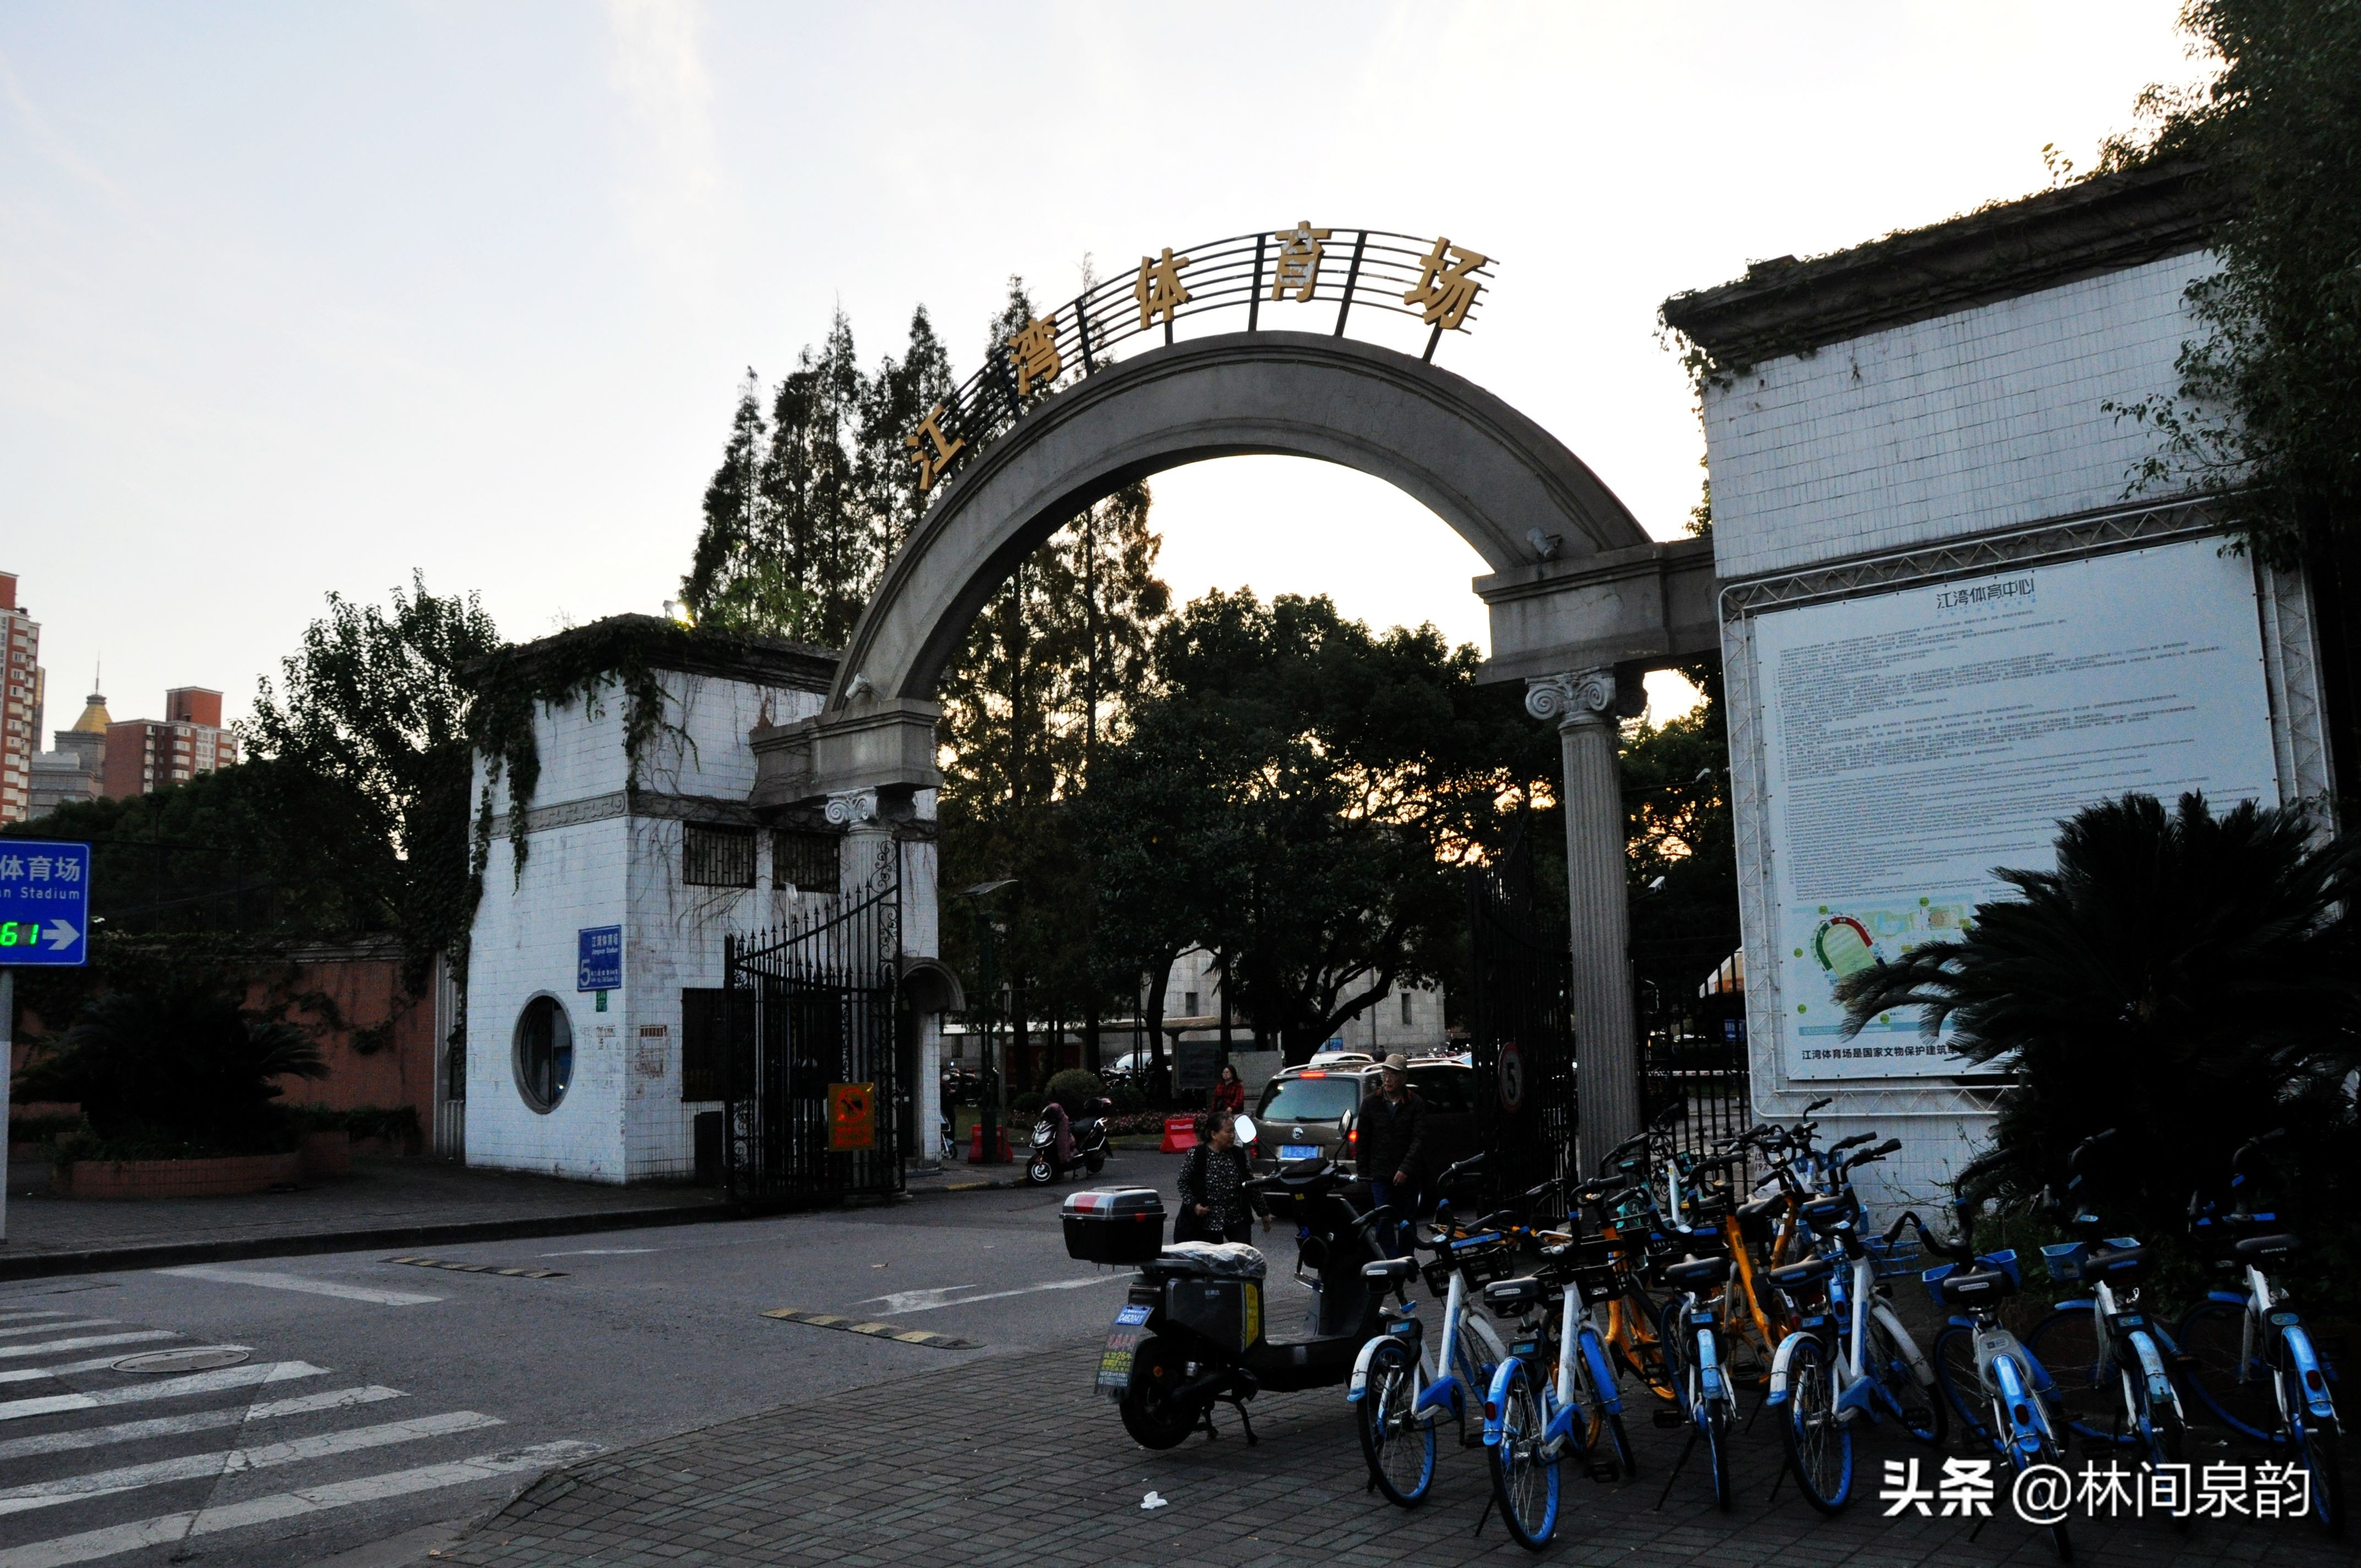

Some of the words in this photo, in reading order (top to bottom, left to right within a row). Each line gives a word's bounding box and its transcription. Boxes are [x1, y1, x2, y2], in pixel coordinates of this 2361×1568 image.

[906, 220, 1488, 491] 江湾体育场
[1936, 578, 2034, 609] 江湾体育中心
[0, 854, 80, 882] 体育场
[20, 886, 79, 900] Stadium
[580, 959, 591, 987] 5
[1507, 1061, 1516, 1100] 5
